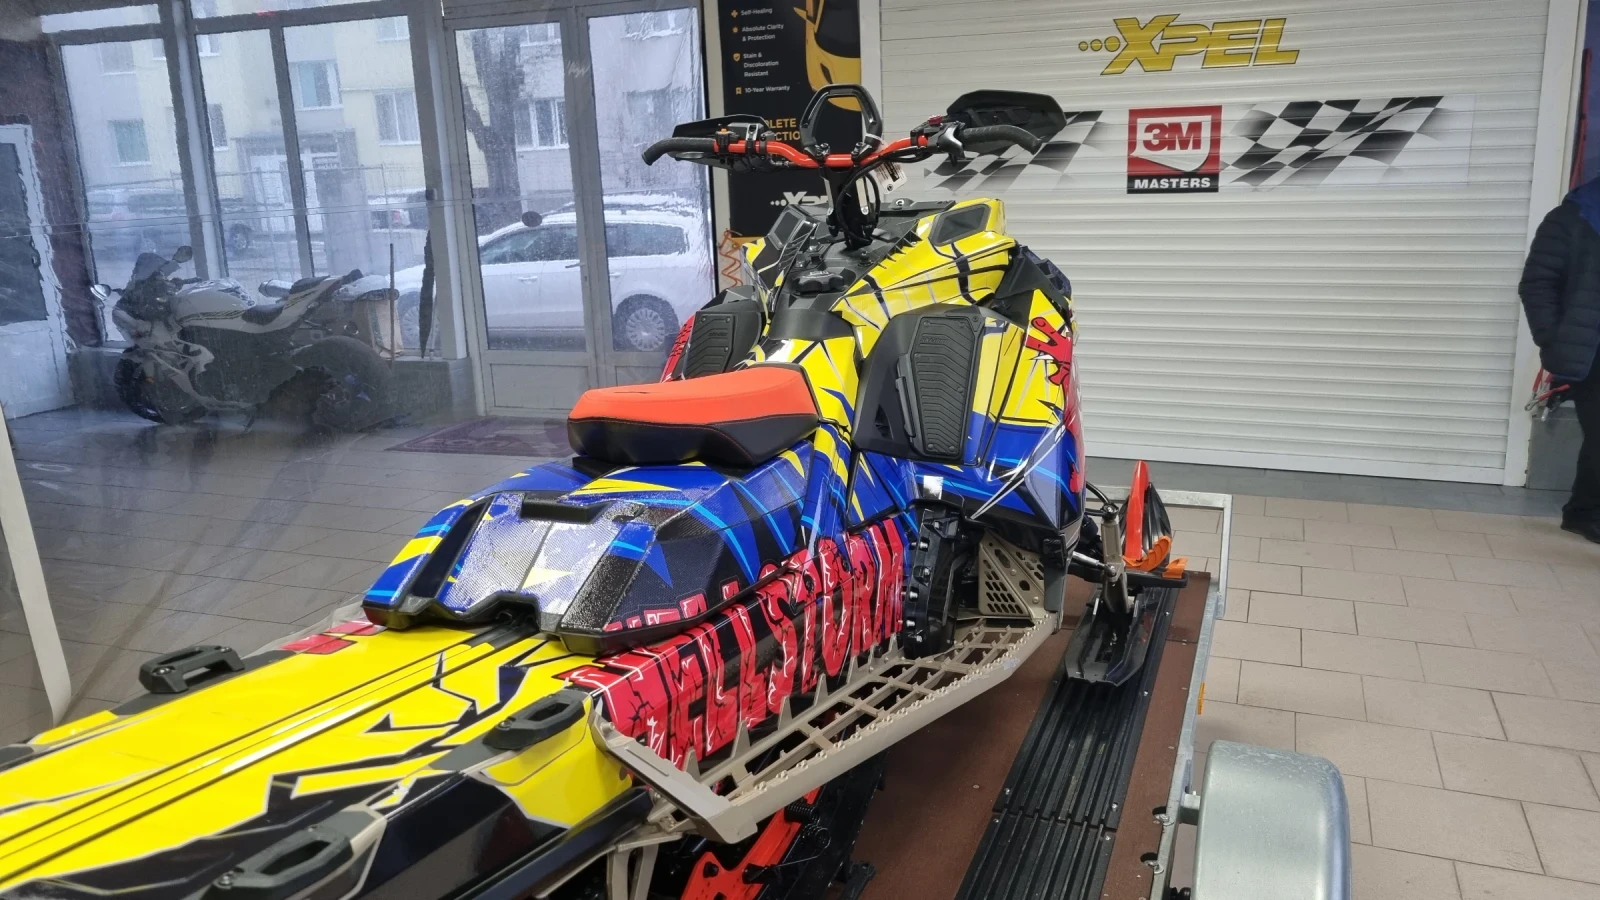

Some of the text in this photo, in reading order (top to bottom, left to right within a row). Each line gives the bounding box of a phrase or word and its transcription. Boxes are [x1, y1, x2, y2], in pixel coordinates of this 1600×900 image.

[741, 8, 773, 16] Self-Healing
[1100, 14, 1300, 75] XPEL
[775, 131, 801, 141] CTIO
[1143, 121, 1203, 152] 3M
[1134, 177, 1211, 190] MASTERS
